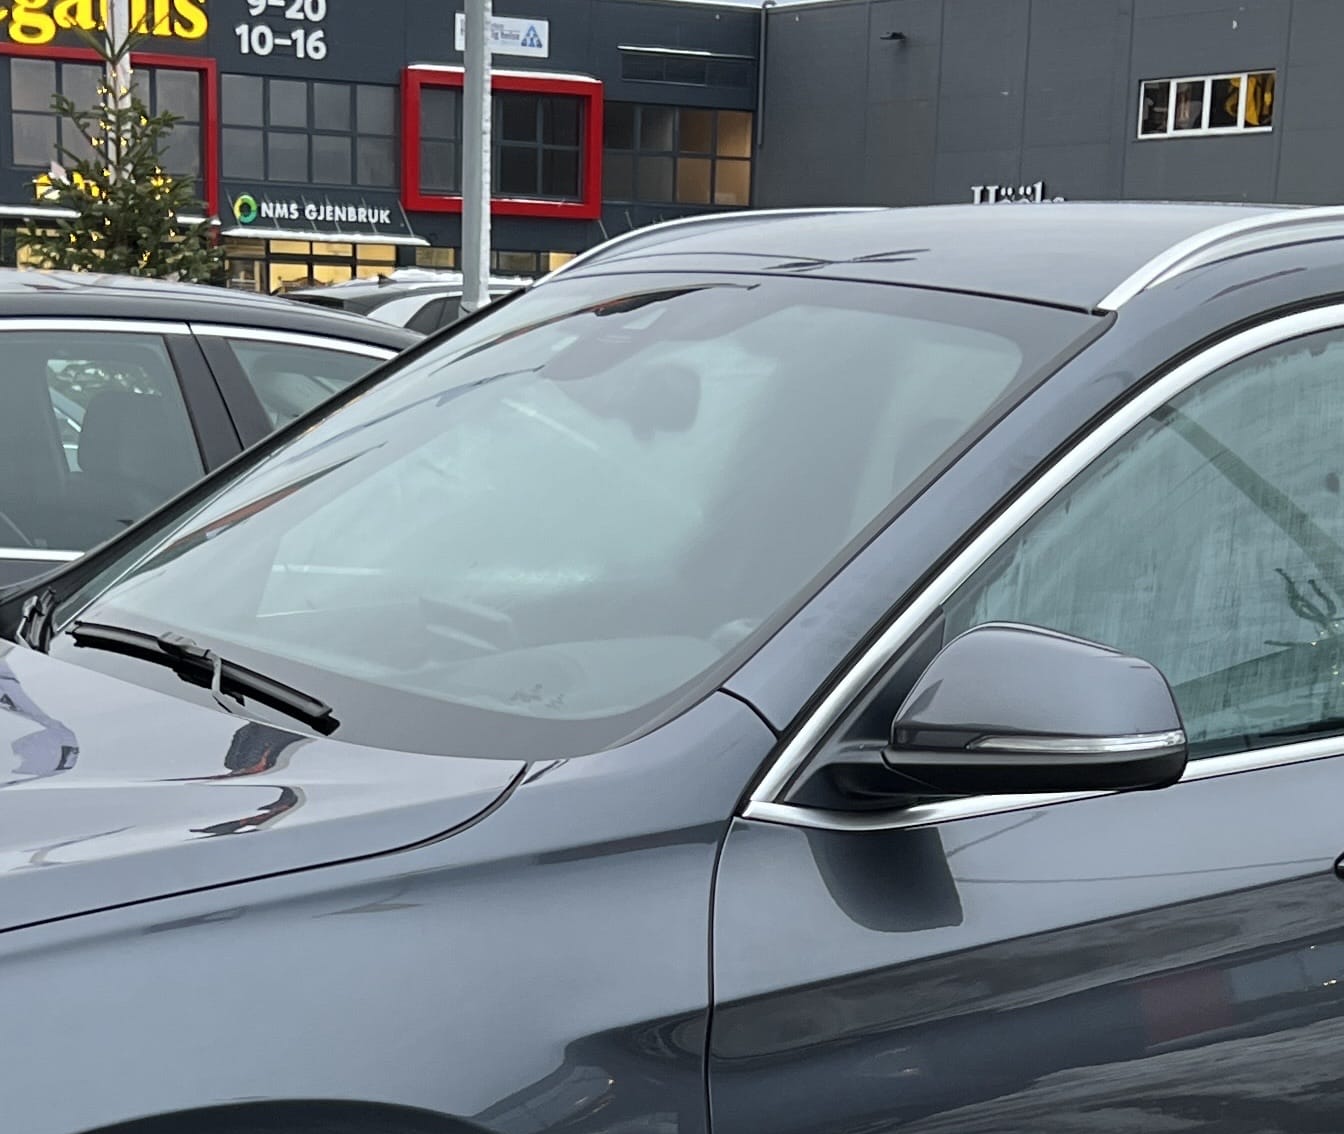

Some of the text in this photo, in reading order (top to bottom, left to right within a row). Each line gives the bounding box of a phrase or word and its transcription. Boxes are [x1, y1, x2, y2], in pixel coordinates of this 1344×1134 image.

[235, 24, 327, 60] 10-16
[260, 202, 391, 224] NMS GJENBRUK
